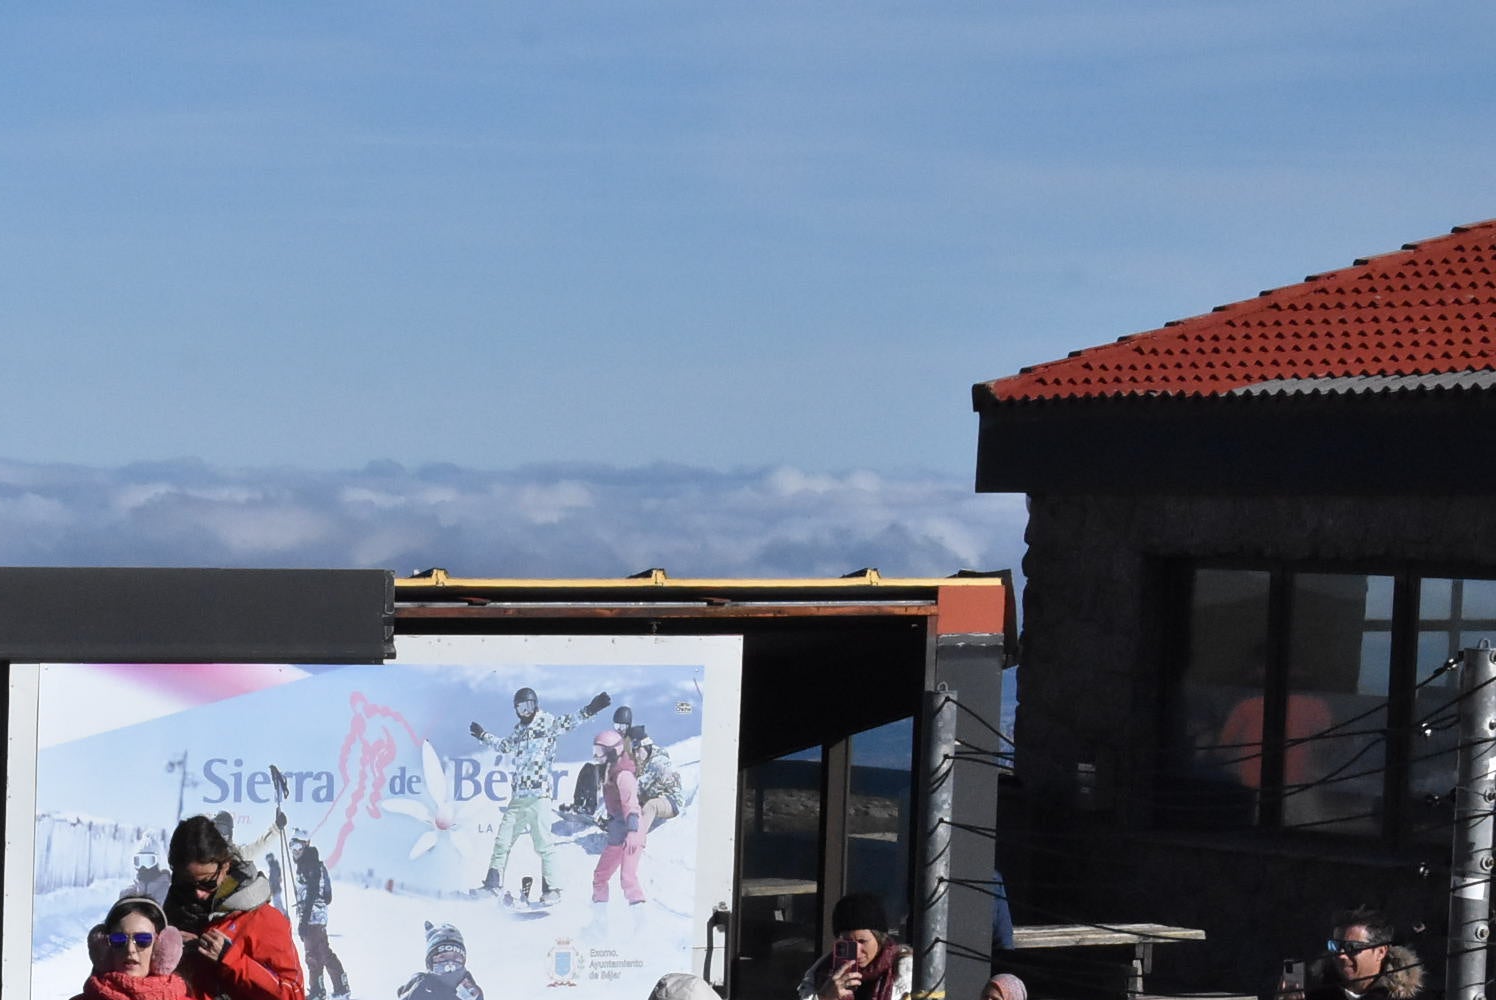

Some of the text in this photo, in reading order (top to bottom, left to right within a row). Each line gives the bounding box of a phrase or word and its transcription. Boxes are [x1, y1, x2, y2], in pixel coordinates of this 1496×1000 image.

[202, 755, 568, 813] Sierra de Bér
[478, 823, 494, 834] LA
[589, 959, 644, 970] Ayuntamiento
[589, 969, 621, 981] de Béjar
